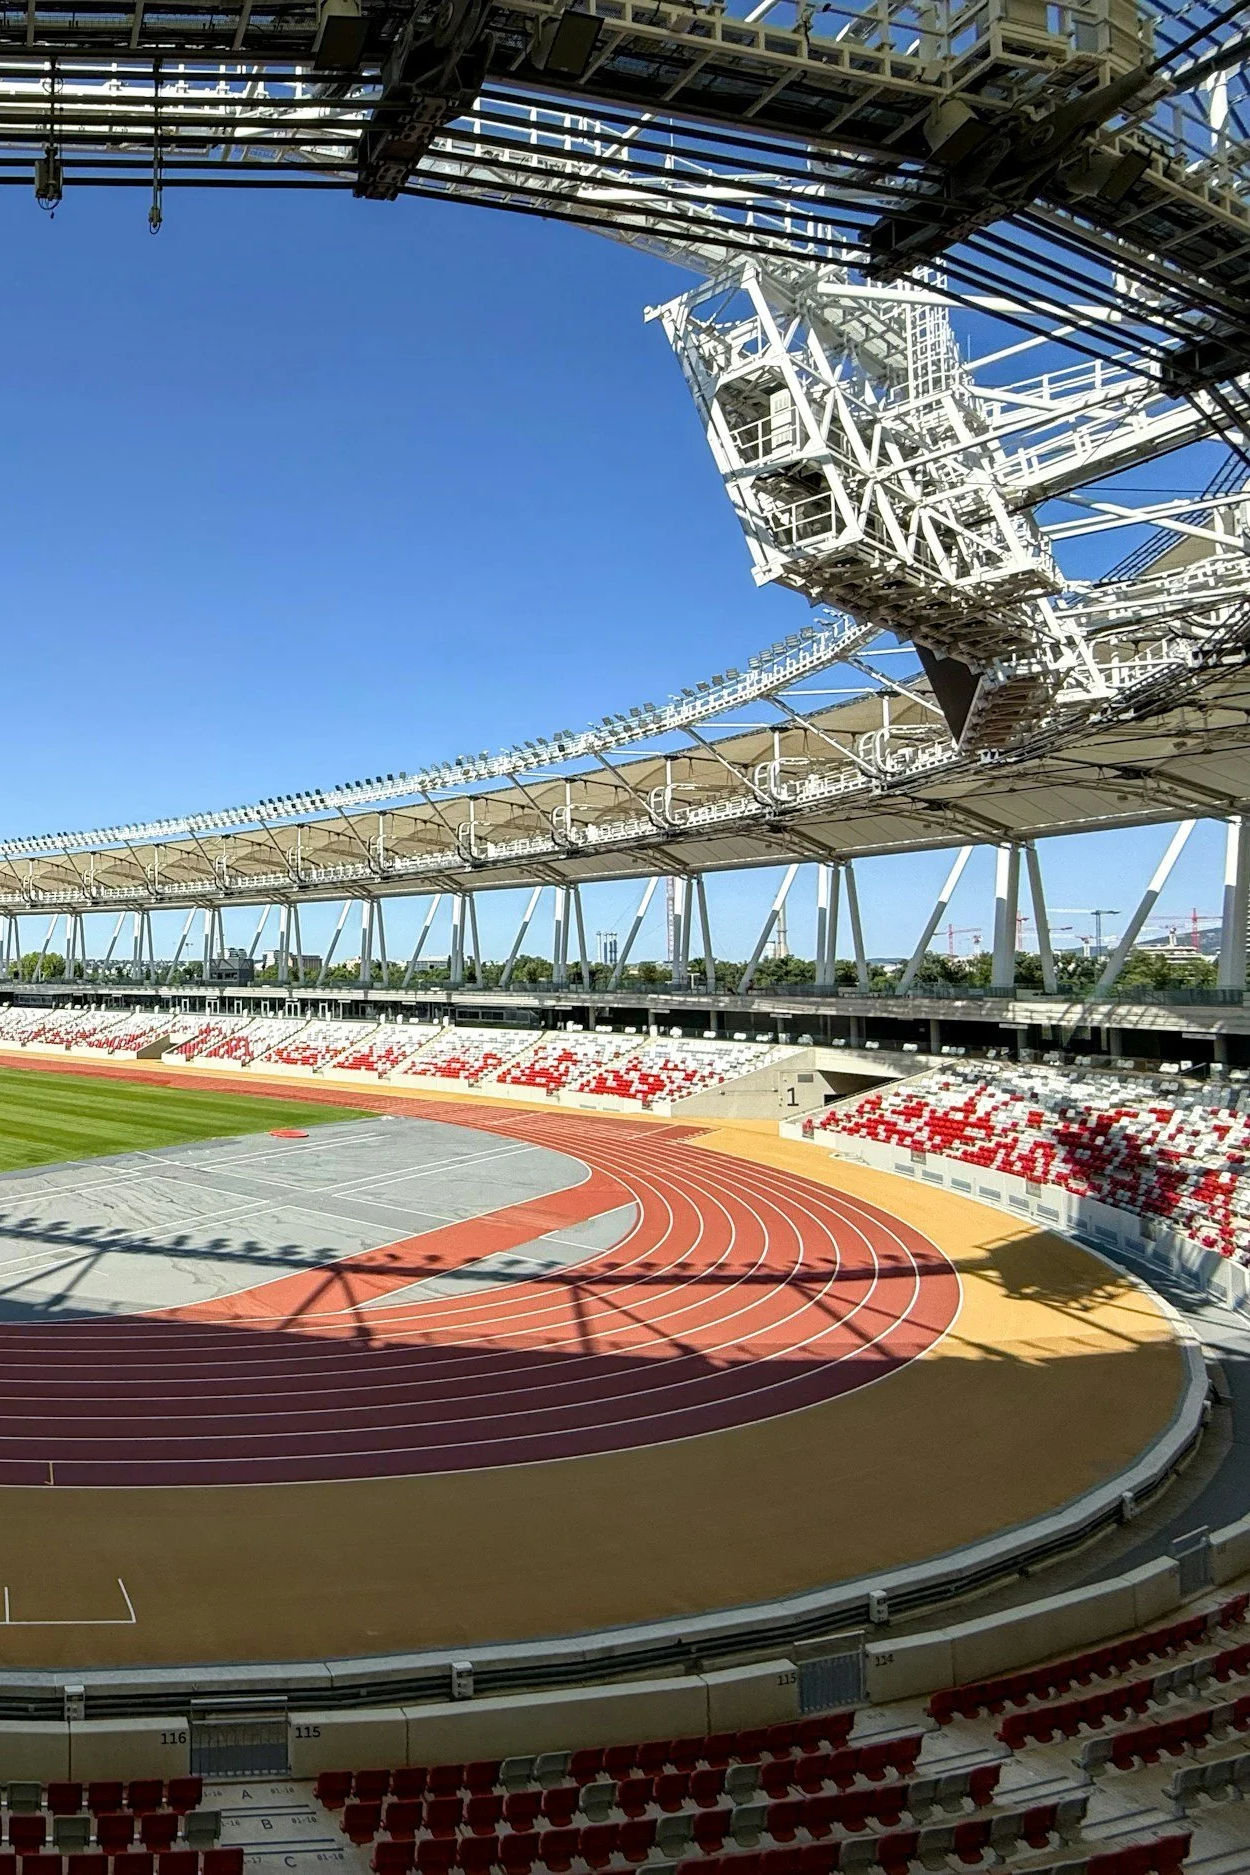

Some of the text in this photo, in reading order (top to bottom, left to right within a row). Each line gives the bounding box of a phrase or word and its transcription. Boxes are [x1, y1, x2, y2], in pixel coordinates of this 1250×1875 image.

[787, 1087, 799, 1106] 1
[778, 1673, 796, 1686] 115
[161, 1732, 187, 1744] 116
[295, 1727, 320, 1739] 115
[241, 1789, 253, 1800] A
[261, 1819, 273, 1829] B
[284, 1856, 297, 1868] C
